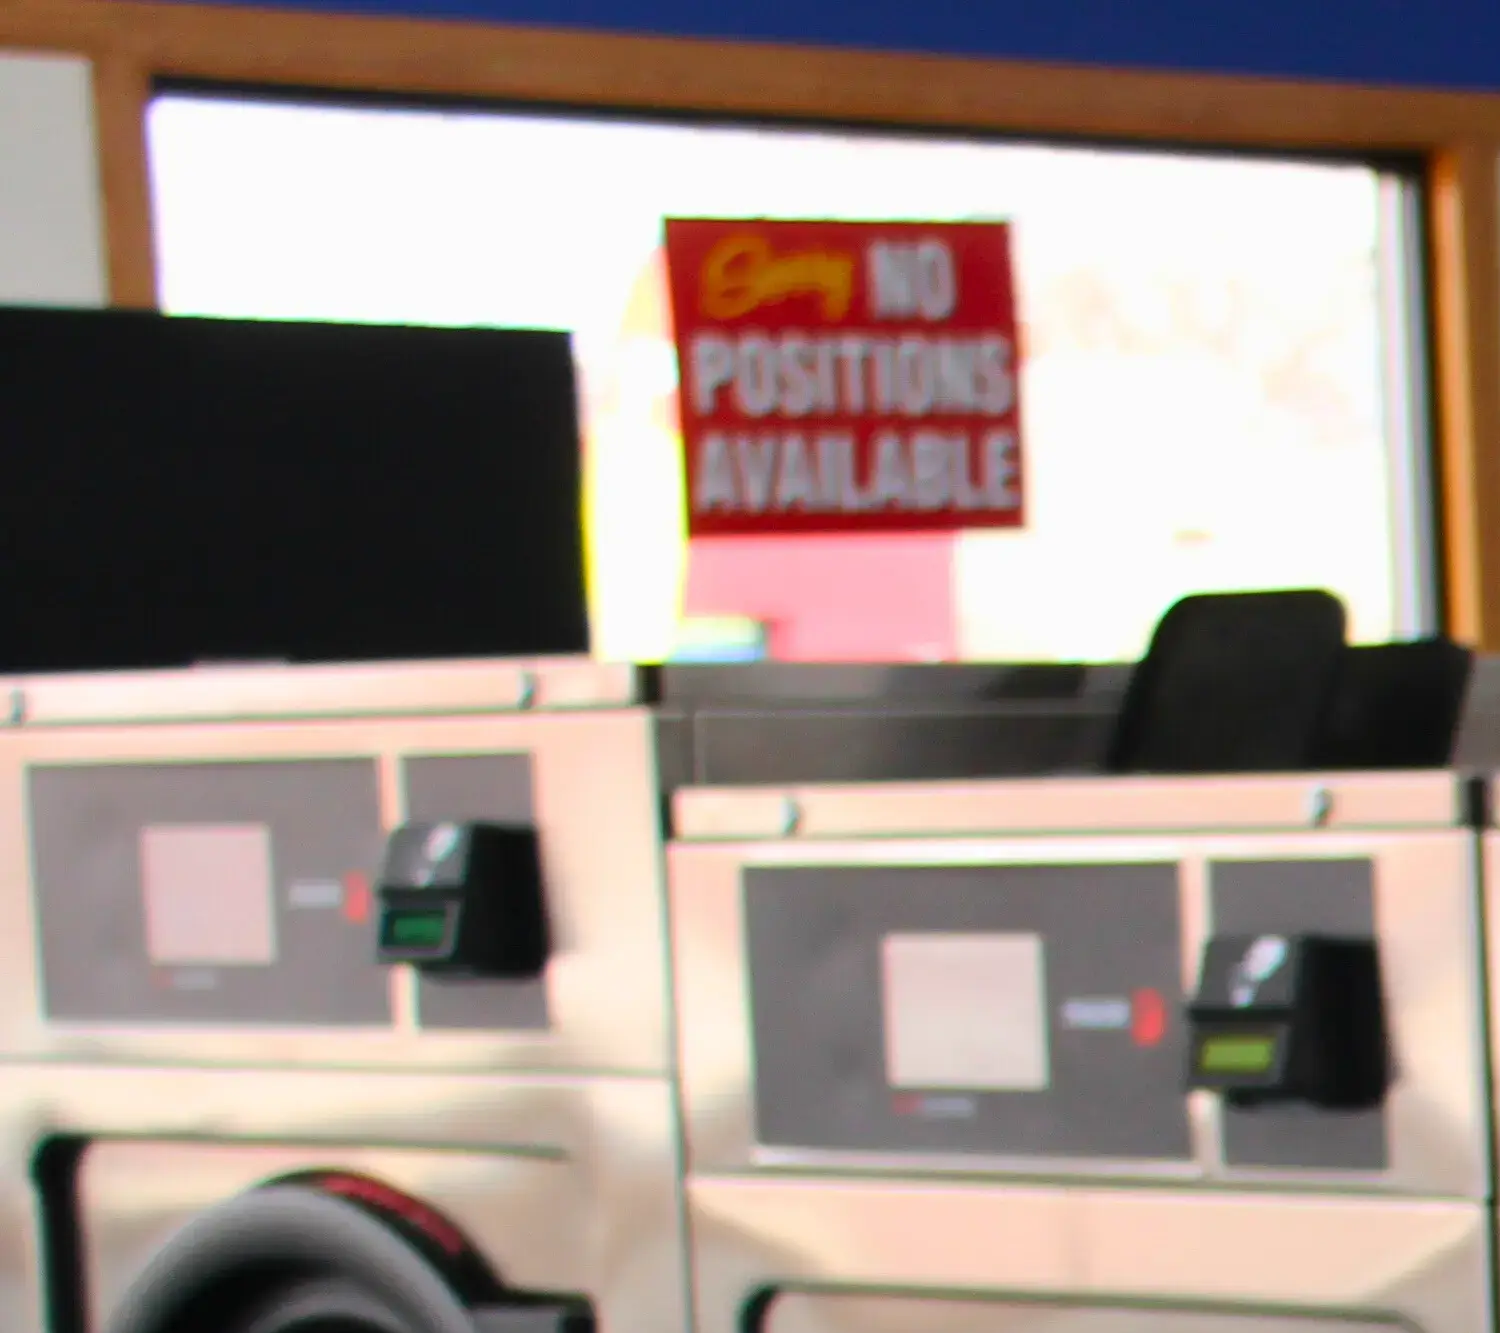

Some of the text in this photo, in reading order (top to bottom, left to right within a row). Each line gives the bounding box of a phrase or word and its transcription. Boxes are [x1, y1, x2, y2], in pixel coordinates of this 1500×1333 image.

[867, 238, 956, 321] NO
[691, 332, 1014, 417] POSITIONS
[695, 431, 1020, 514] AVAILABLE
